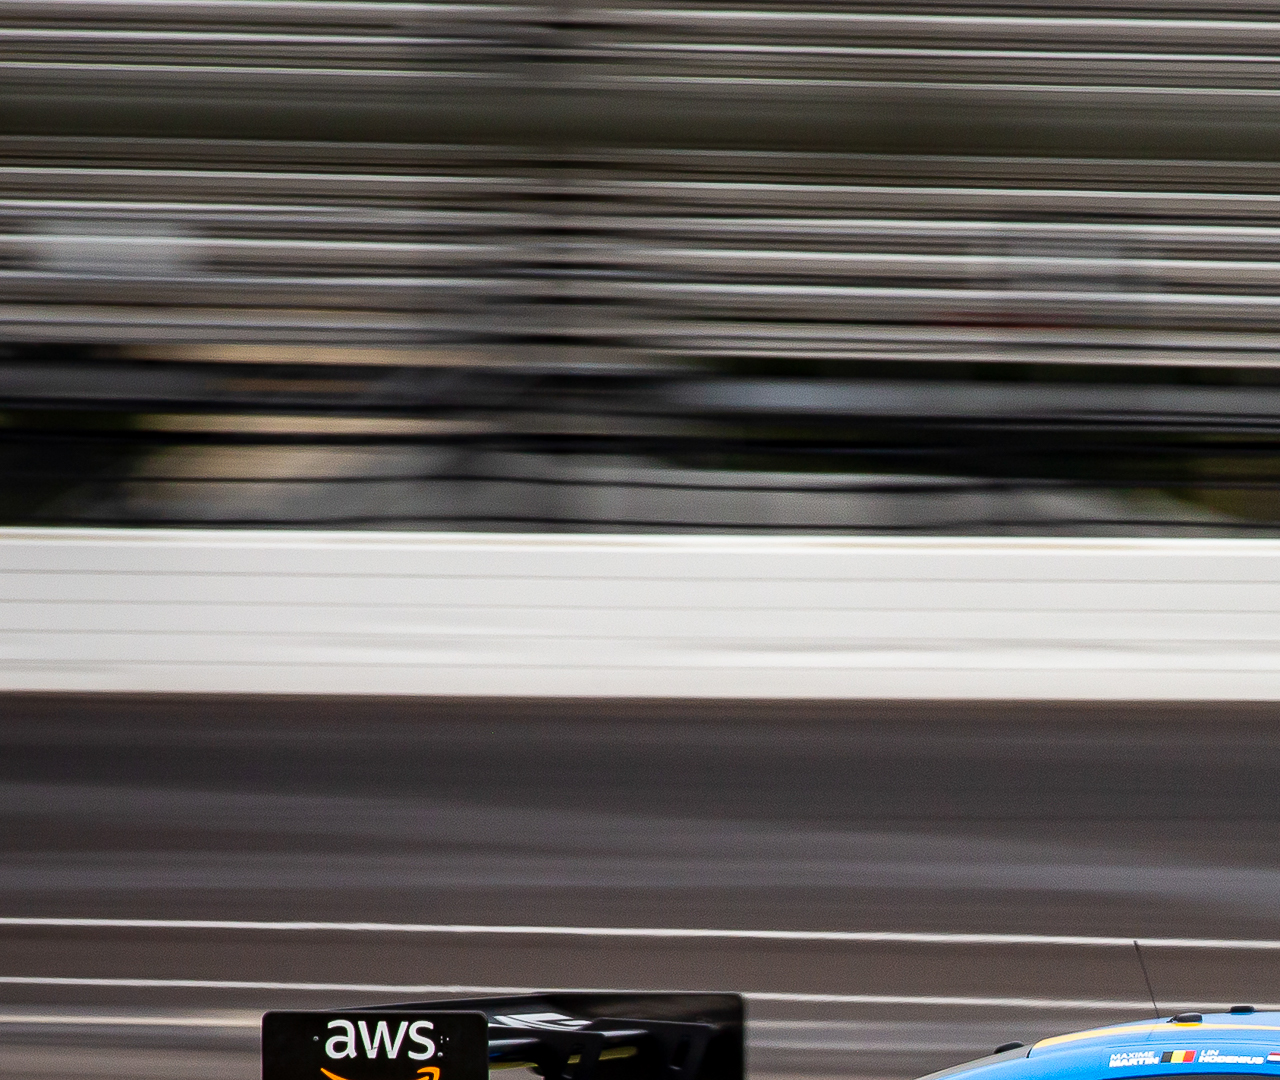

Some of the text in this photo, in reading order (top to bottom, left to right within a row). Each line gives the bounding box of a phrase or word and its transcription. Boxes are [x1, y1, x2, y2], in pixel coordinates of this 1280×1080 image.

[325, 1019, 436, 1060] aws
[1110, 1051, 1155, 1060] MAXIME
[1109, 1057, 1159, 1067] MARTIN
